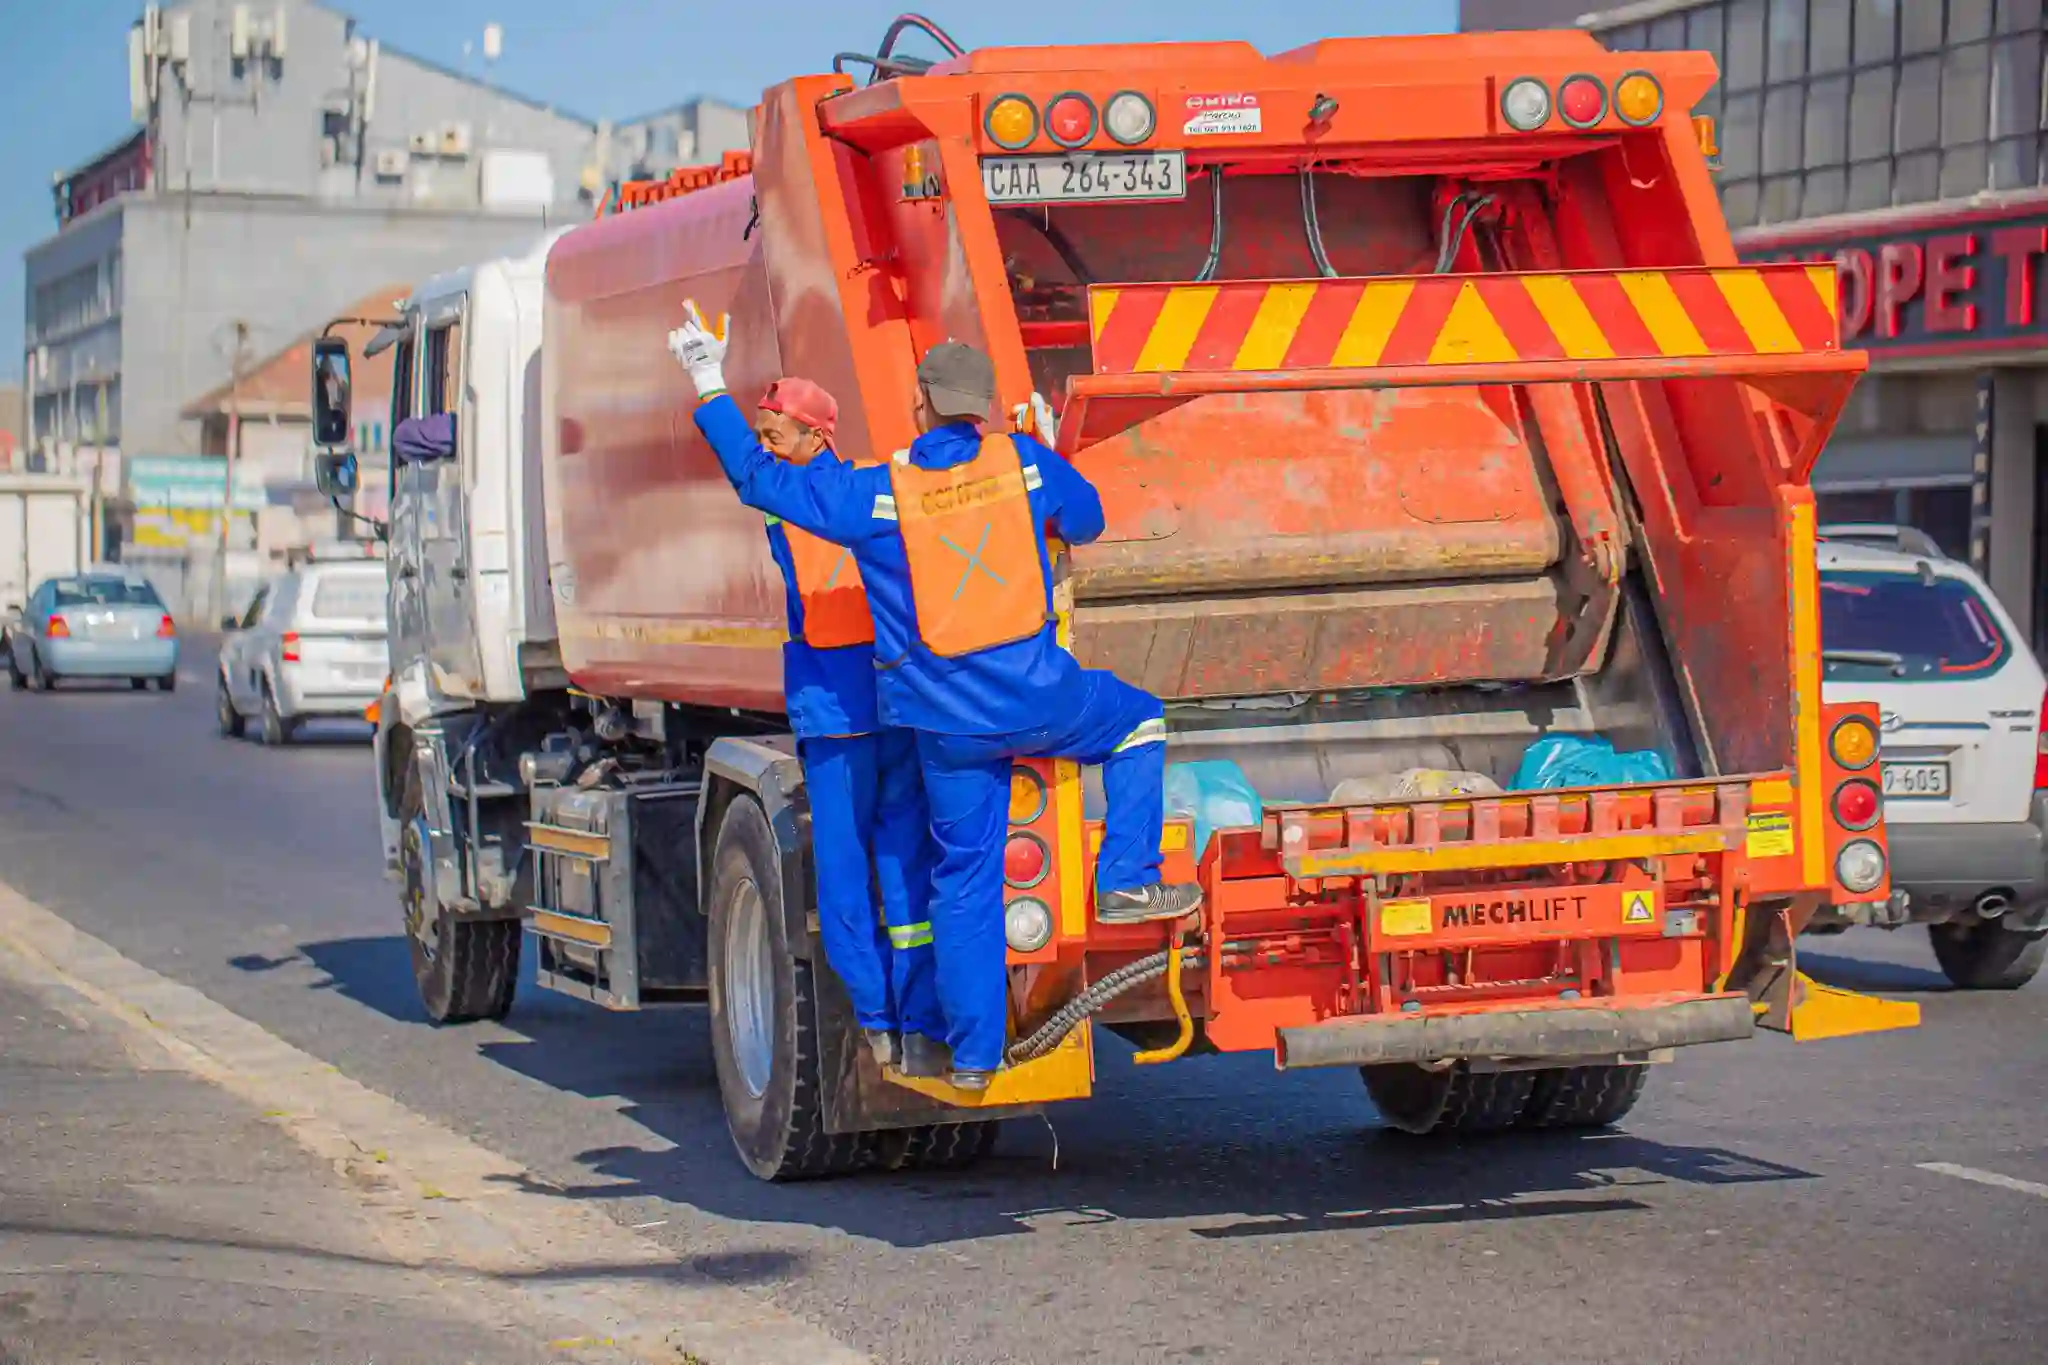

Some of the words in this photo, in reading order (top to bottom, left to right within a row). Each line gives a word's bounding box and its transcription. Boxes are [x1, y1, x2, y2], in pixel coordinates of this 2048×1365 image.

[991, 163, 1040, 195] CAA
[1062, 159, 1172, 192] 264-343
[1442, 896, 1587, 928] MECHLIFT
